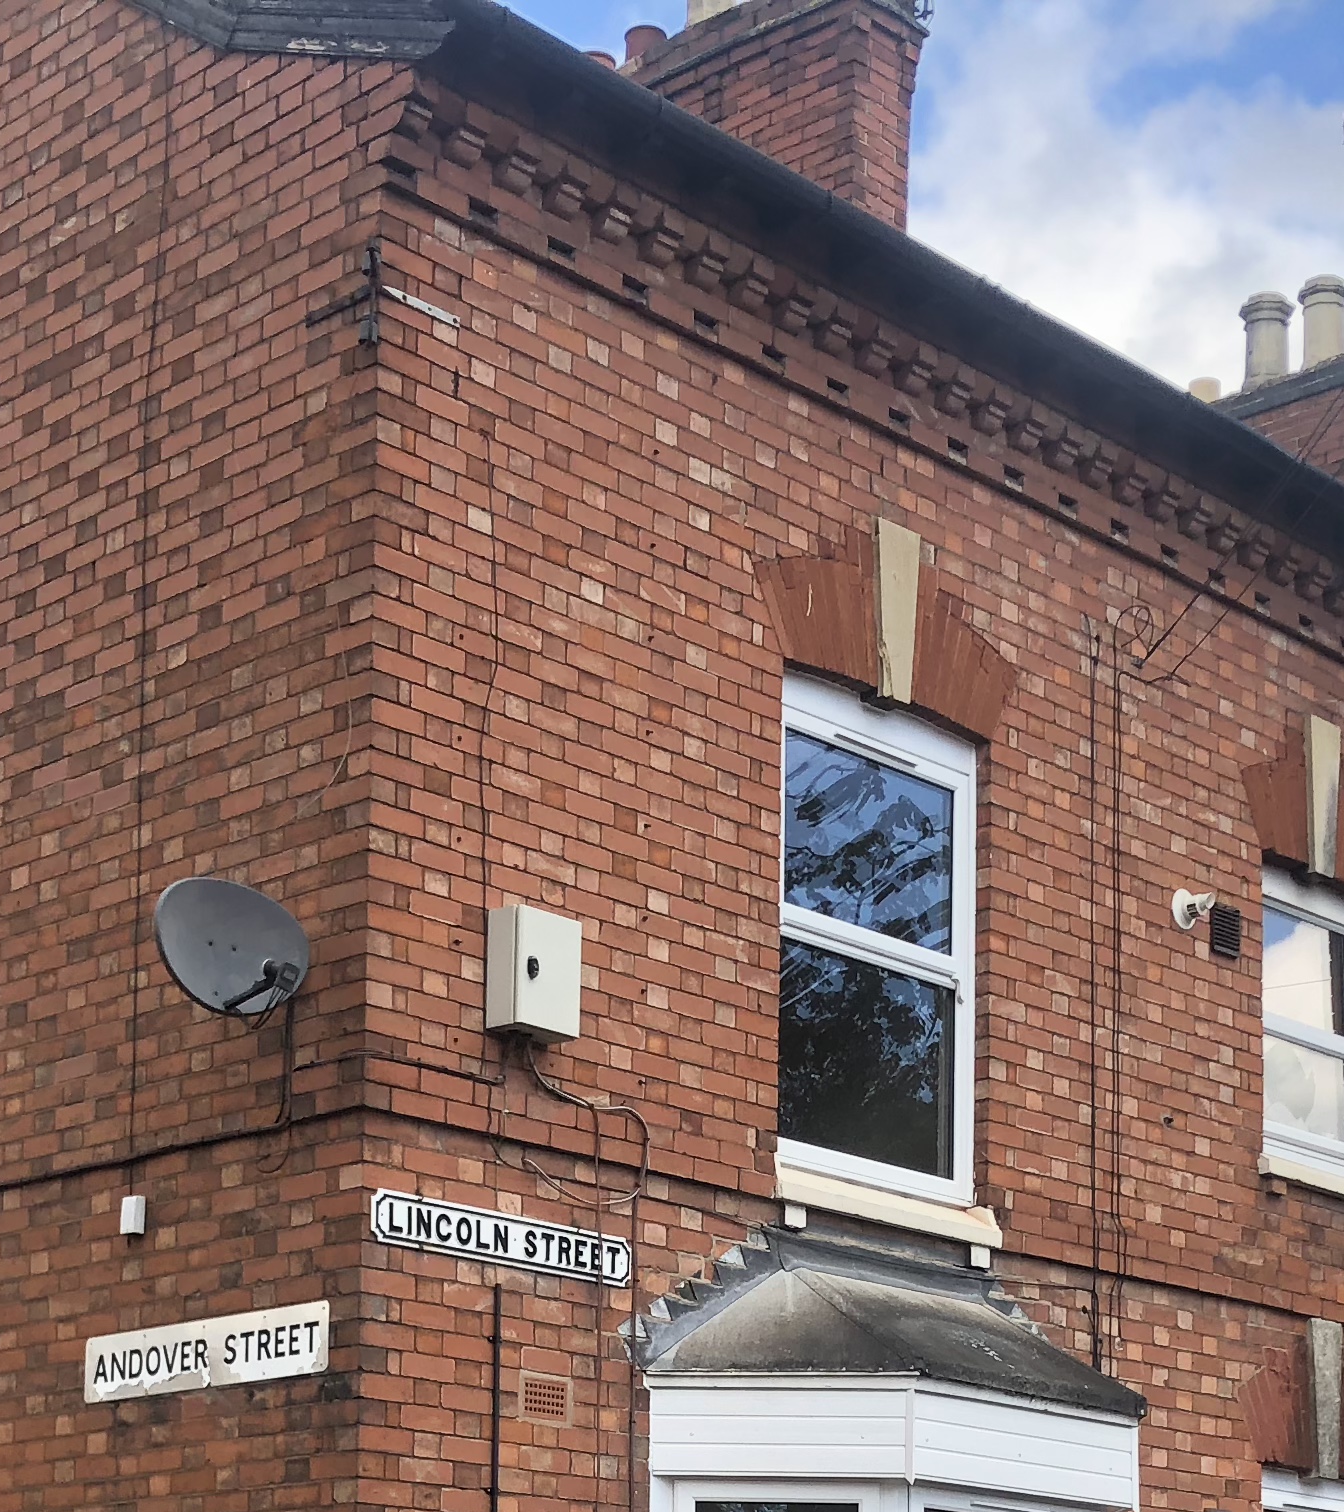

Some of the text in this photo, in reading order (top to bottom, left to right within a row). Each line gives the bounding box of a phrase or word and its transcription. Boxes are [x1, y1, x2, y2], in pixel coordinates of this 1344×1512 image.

[388, 1202, 621, 1274] LINCOLN STREET
[93, 1320, 320, 1384] ANDOVER STREET
